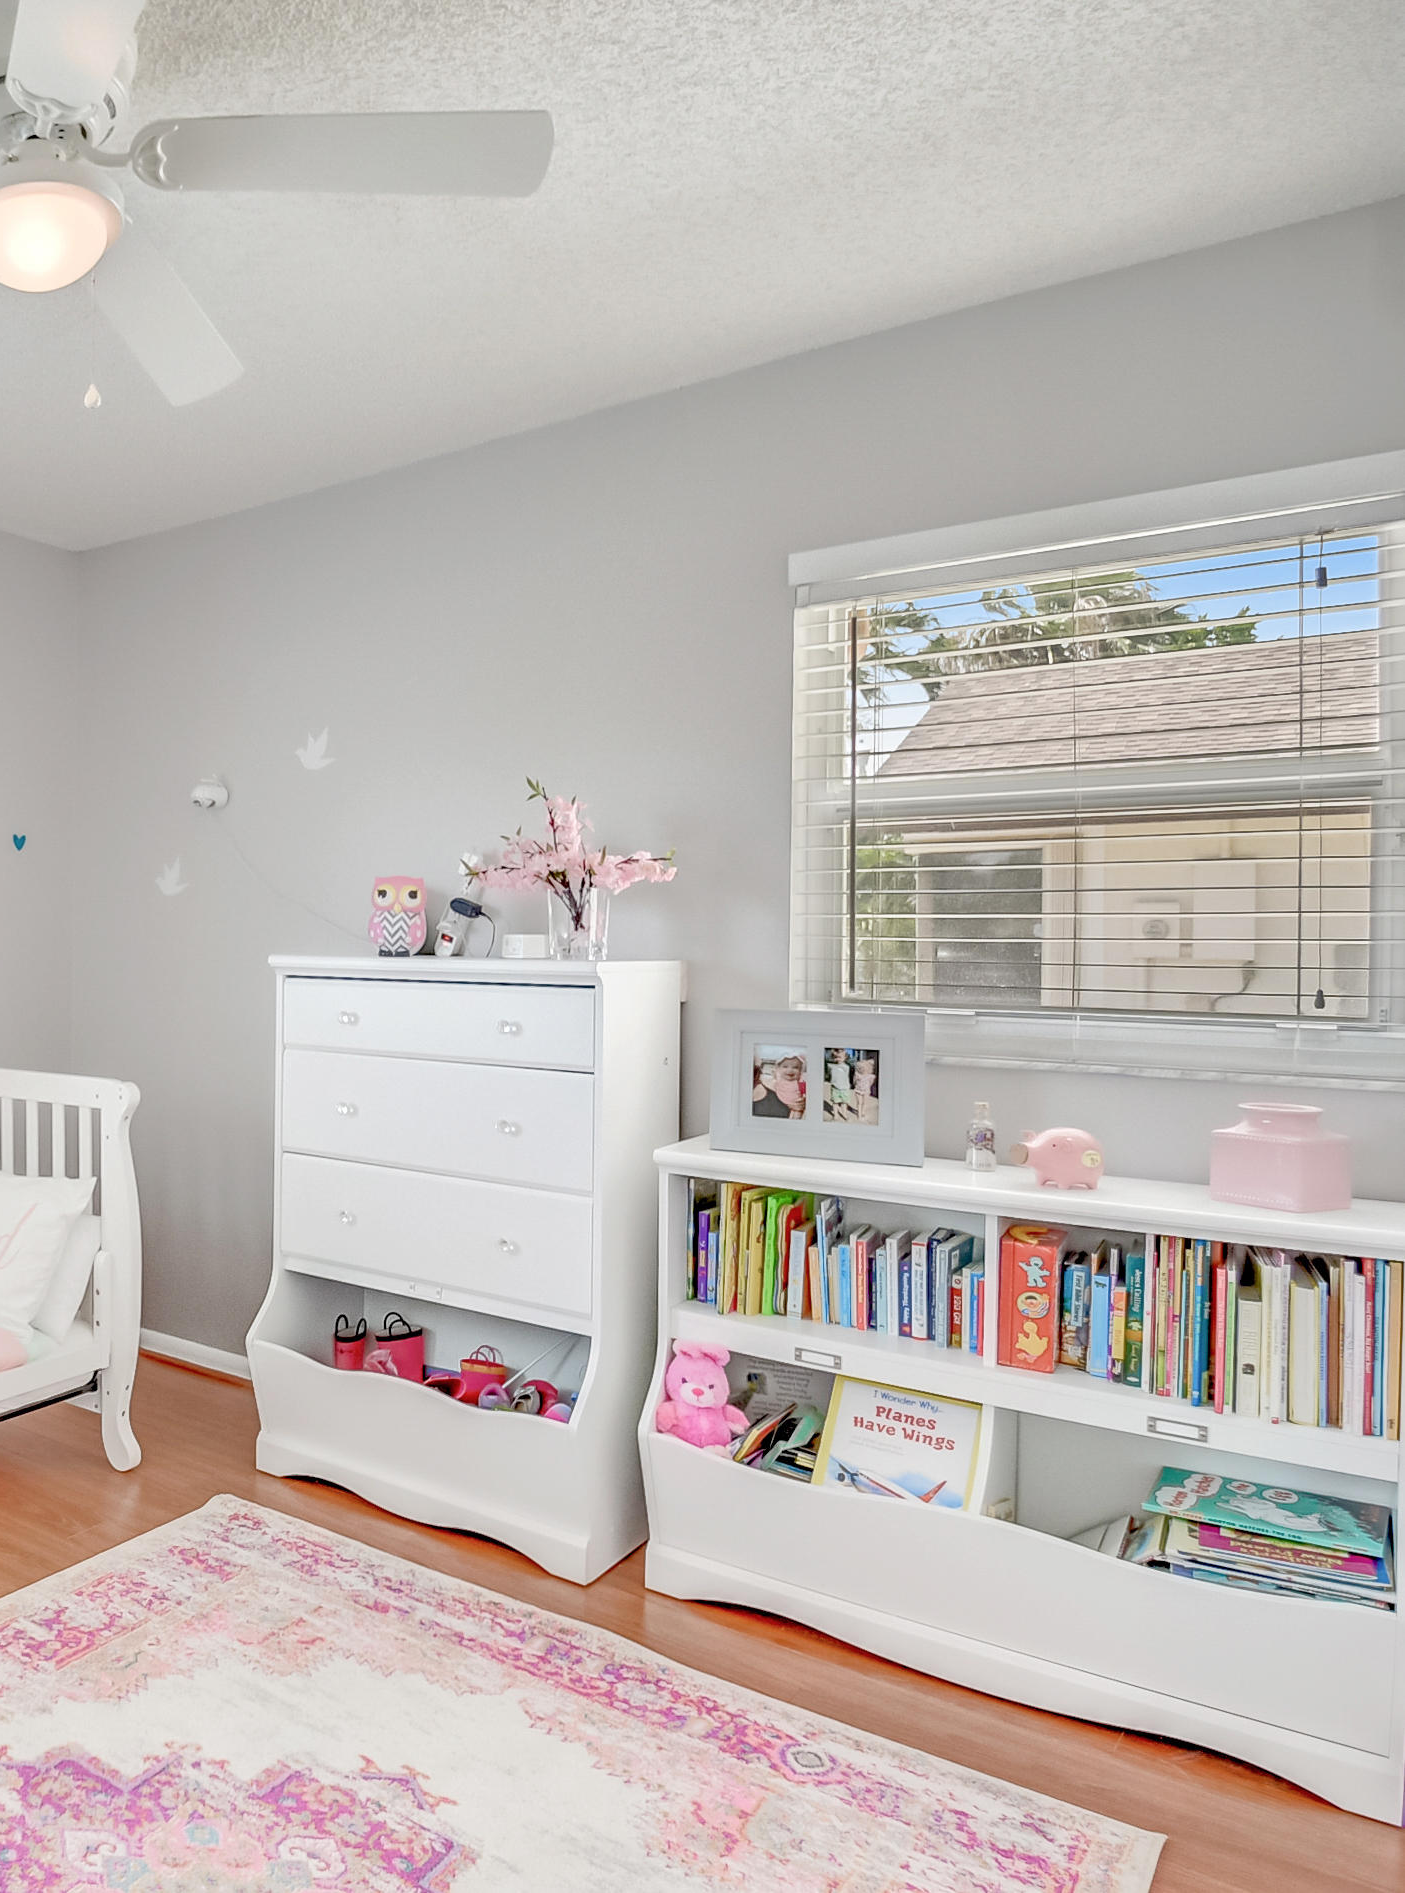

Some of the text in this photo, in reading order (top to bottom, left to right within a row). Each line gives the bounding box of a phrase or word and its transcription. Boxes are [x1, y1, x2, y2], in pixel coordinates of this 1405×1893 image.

[873, 1390, 879, 1399] I
[880, 1391, 916, 1406] Wonder
[875, 1405, 937, 1430] Planes
[853, 1416, 896, 1436] Have
[902, 1427, 956, 1451] Wings
